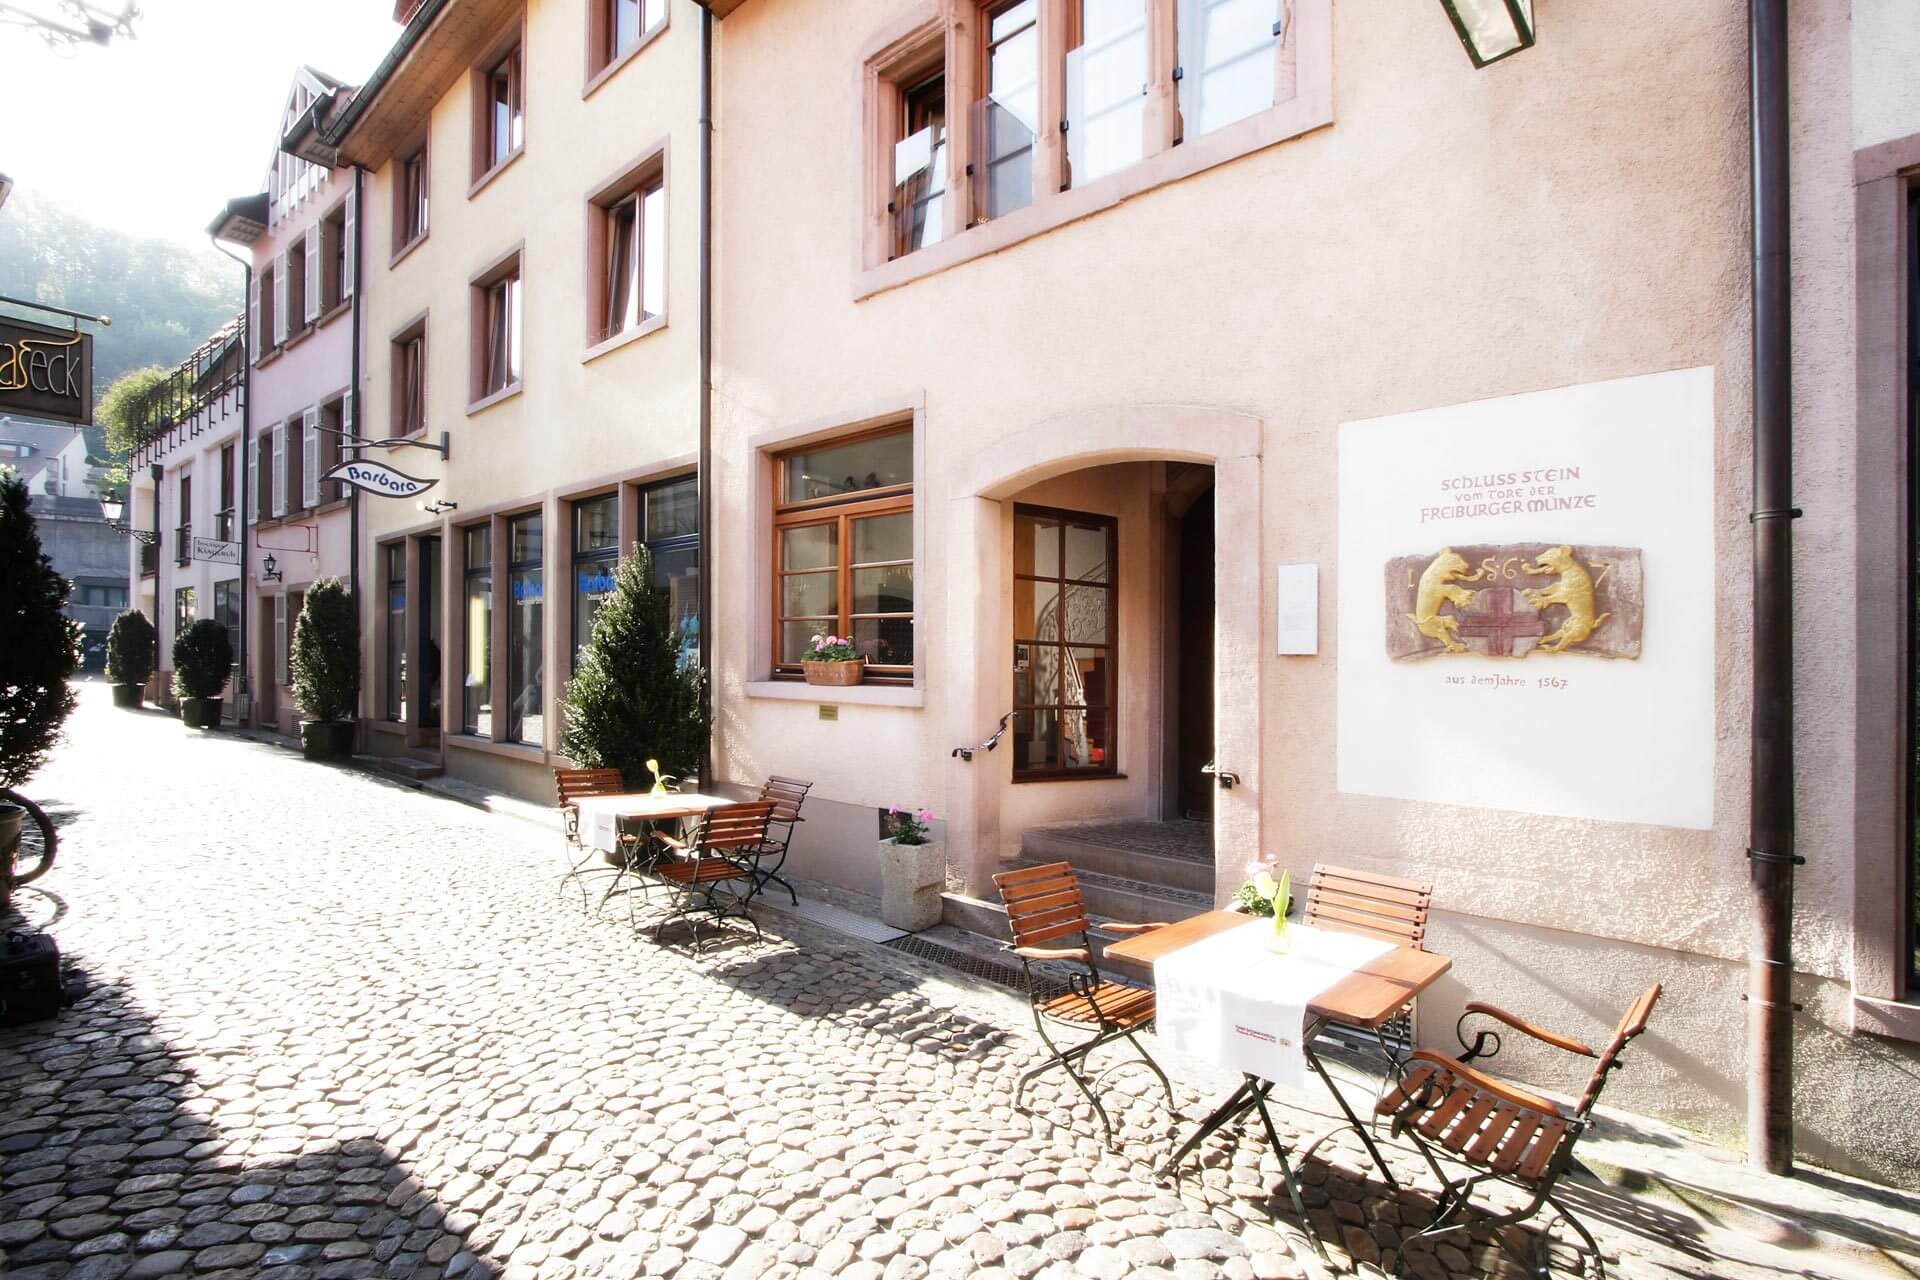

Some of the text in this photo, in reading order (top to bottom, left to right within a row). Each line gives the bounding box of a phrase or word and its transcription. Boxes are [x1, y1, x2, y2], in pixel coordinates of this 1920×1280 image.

[347, 466, 417, 493] Barbara
[1521, 466, 1580, 483] STEIN
[1487, 488, 1524, 500] TORE
[1420, 500, 1524, 523] FREIBURGER
[1445, 675, 1465, 685] aus
[1538, 676, 1569, 691] 1567
